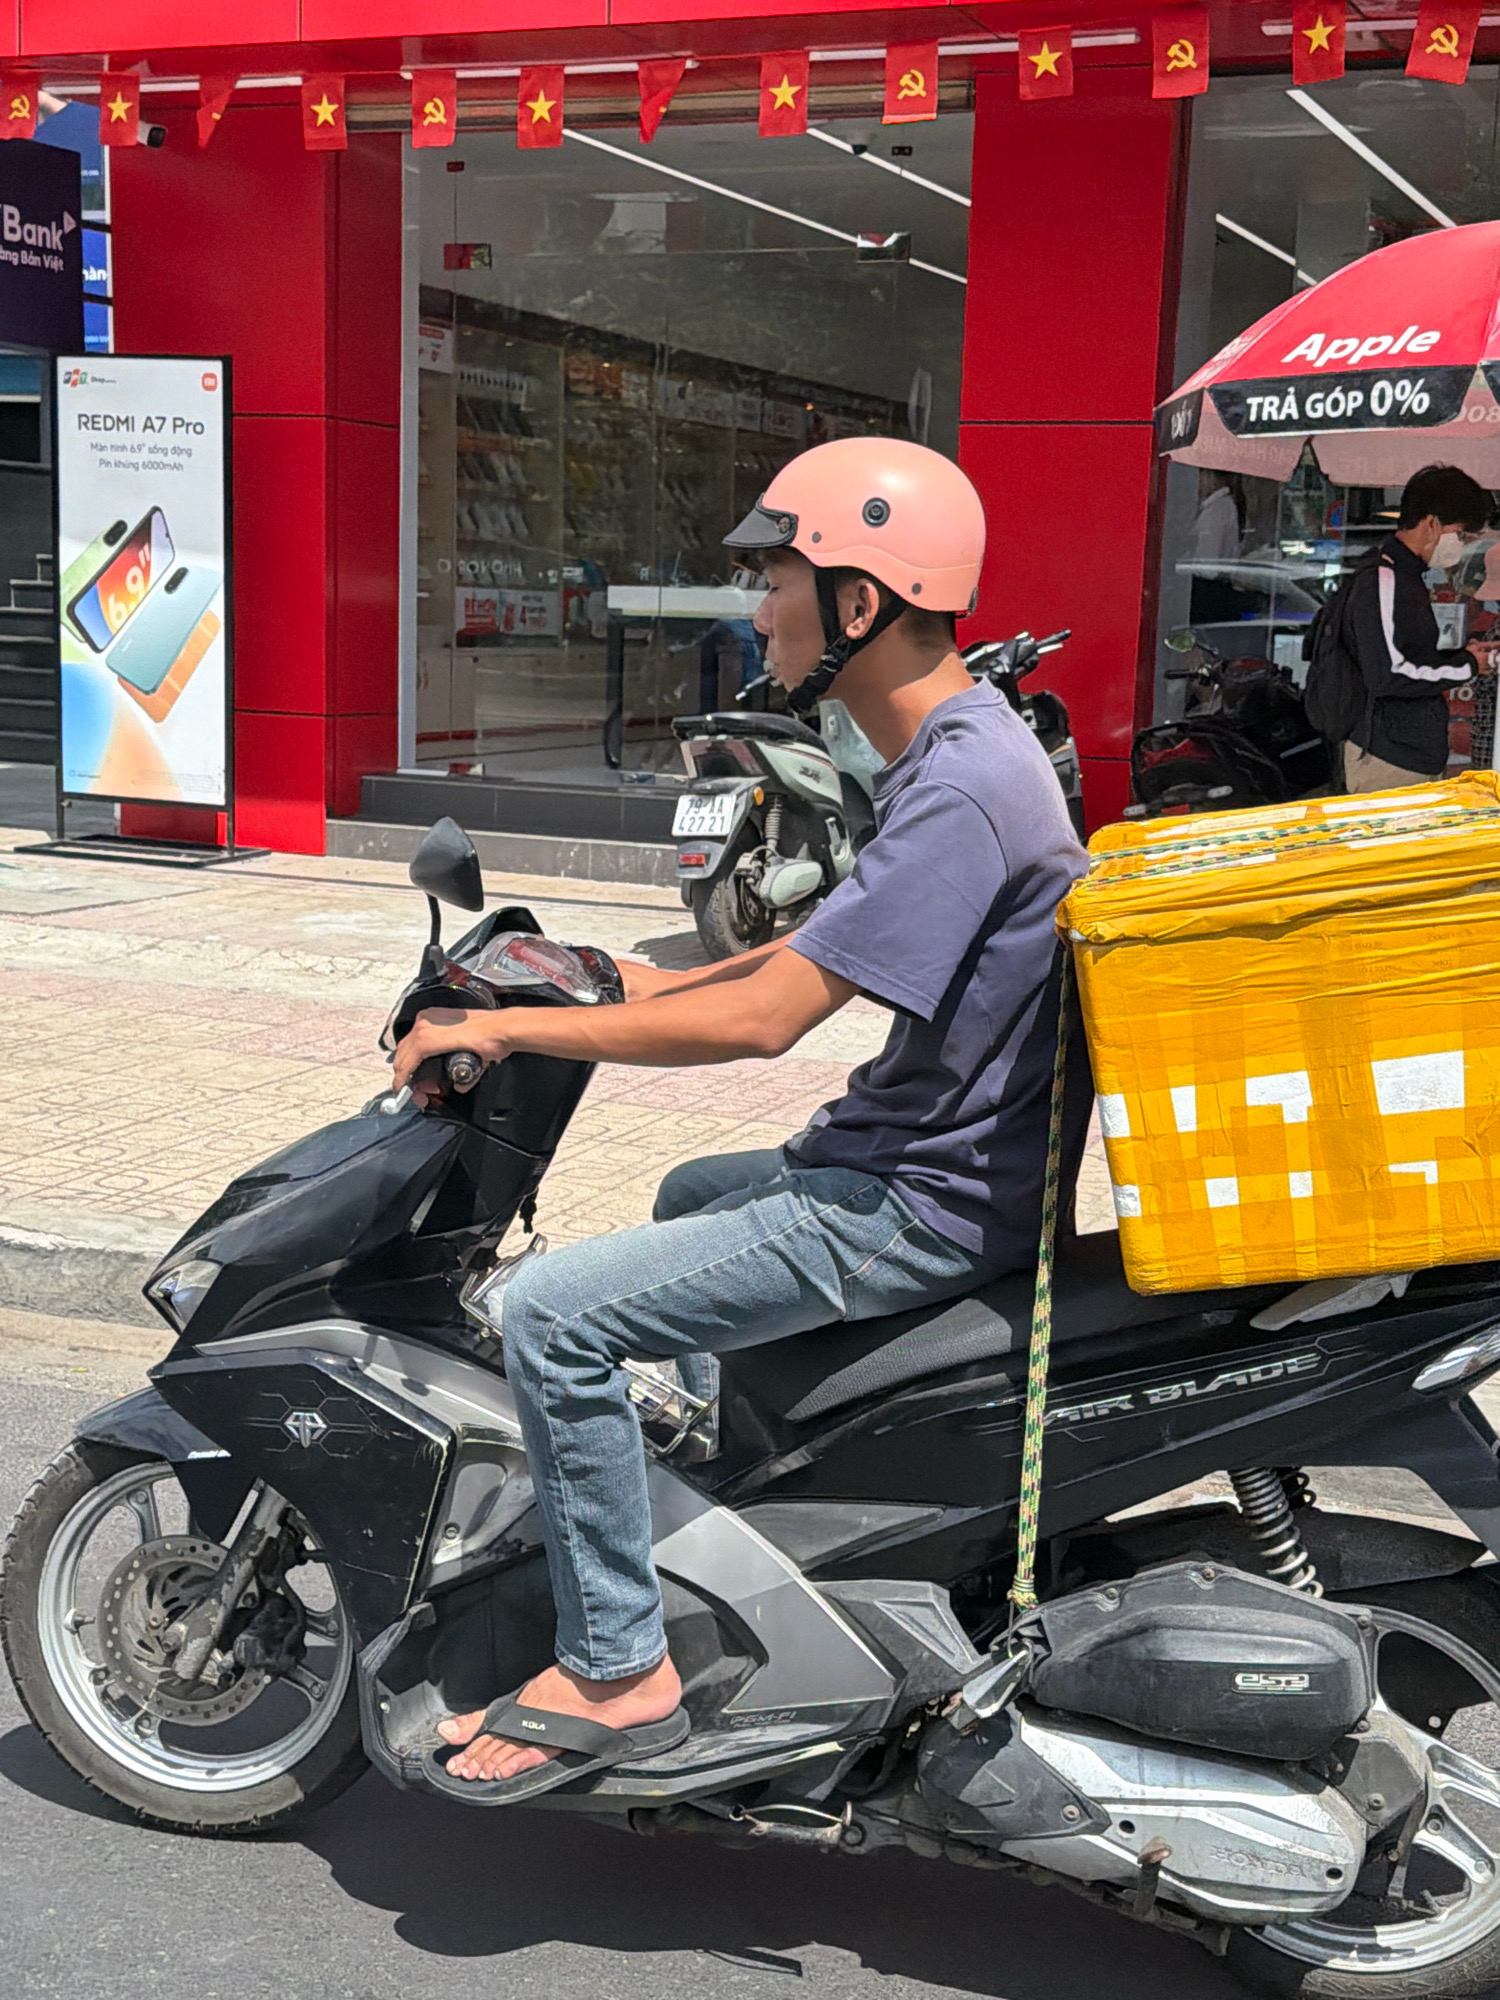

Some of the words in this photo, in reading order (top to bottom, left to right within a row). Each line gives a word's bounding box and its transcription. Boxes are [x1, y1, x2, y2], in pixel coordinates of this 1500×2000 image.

[0, 203, 63, 252] Bank
[21, 250, 41, 267] Bản
[43, 254, 64, 273] Việt
[1281, 325, 1441, 367] Apple
[1247, 387, 1299, 421] TRẢ
[1305, 386, 1364, 419] GÓP
[1370, 378, 1431, 416] 0%
[77, 413, 135, 433] REDMI
[142, 416, 167, 434] A7
[173, 417, 205, 435] Pro
[90, 442, 108, 453] Màn
[110, 443, 128, 453] hình
[148, 444, 169, 457] sống
[170, 445, 193, 458] động
[99, 458, 113, 469] Pin
[141, 460, 184, 472] 6000mAh
[1043, 1394, 1135, 1427] AIR
[1142, 1353, 1321, 1404] BLADE
